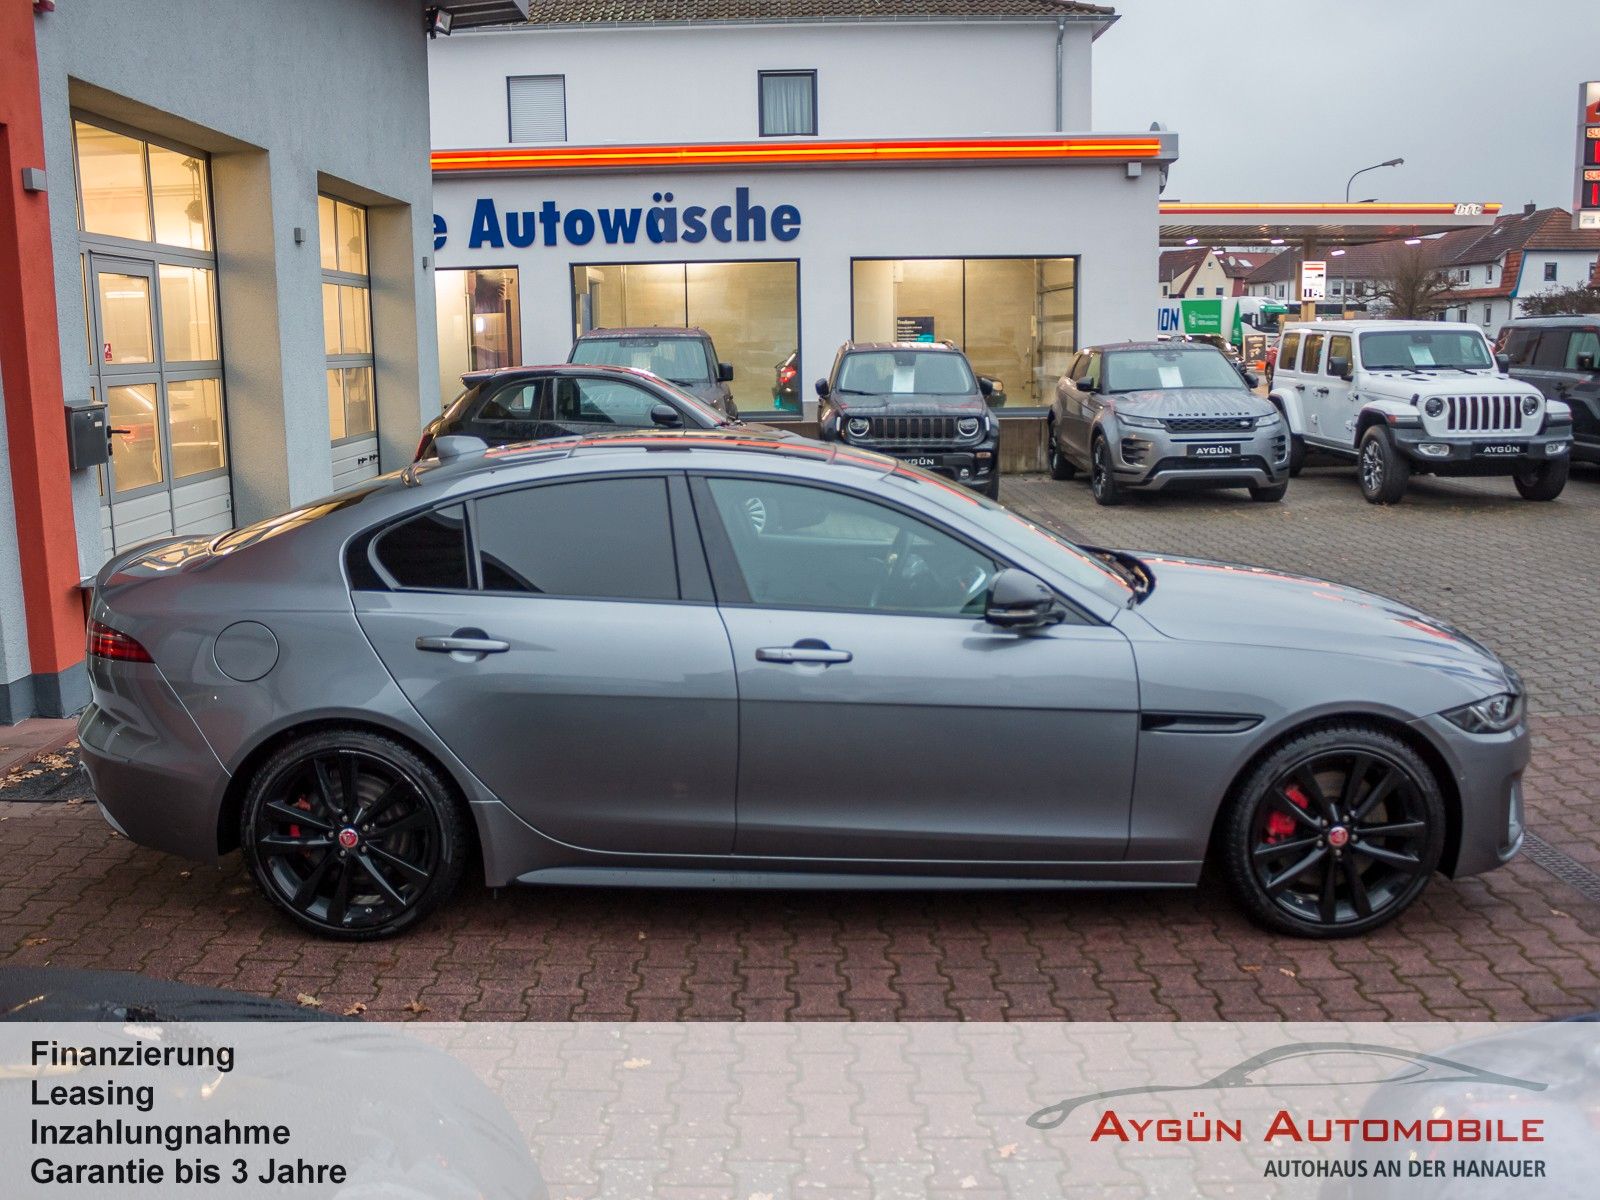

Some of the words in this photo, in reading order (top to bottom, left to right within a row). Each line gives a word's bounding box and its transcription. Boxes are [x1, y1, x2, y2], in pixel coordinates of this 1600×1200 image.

[468, 186, 802, 249] Autowäsche
[1196, 445, 1233, 454] AYGÜN
[1483, 444, 1520, 453] AYGÜN
[904, 456, 935, 466] YGÜN
